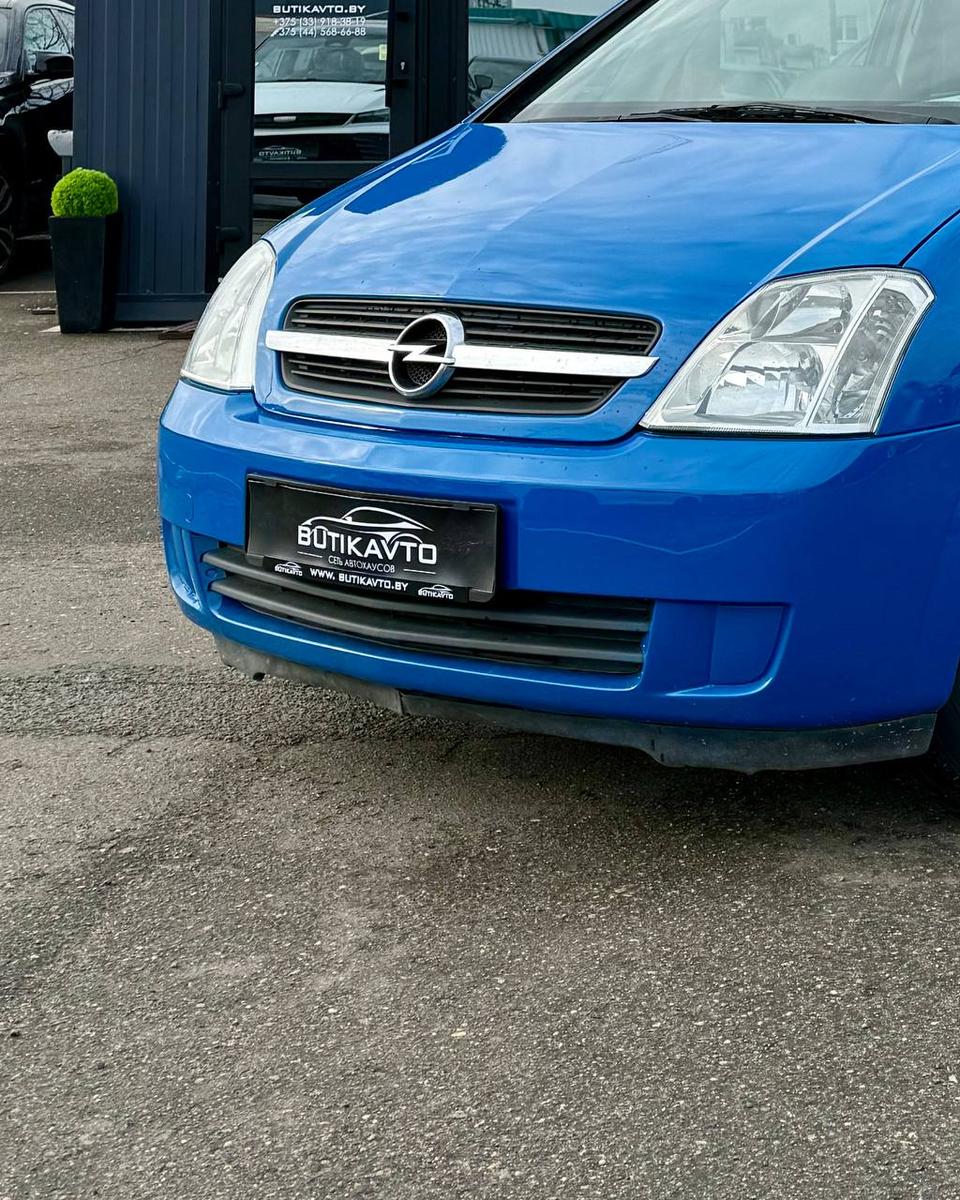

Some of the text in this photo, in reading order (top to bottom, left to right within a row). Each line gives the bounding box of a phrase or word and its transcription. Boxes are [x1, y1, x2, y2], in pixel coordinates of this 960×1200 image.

[273, 5, 366, 13] BUTIKAVTO.BY
[274, 17, 297, 26] +375
[299, 17, 317, 27] (33)
[276, 27, 366, 37] 375 (44) 568-66-88
[297, 525, 437, 565] BUTIKAVTO
[328, 555, 396, 573] СЕТЬ АВТОХАУСОВ
[309, 567, 409, 591] WWW. BUTIKAVTO.BY
